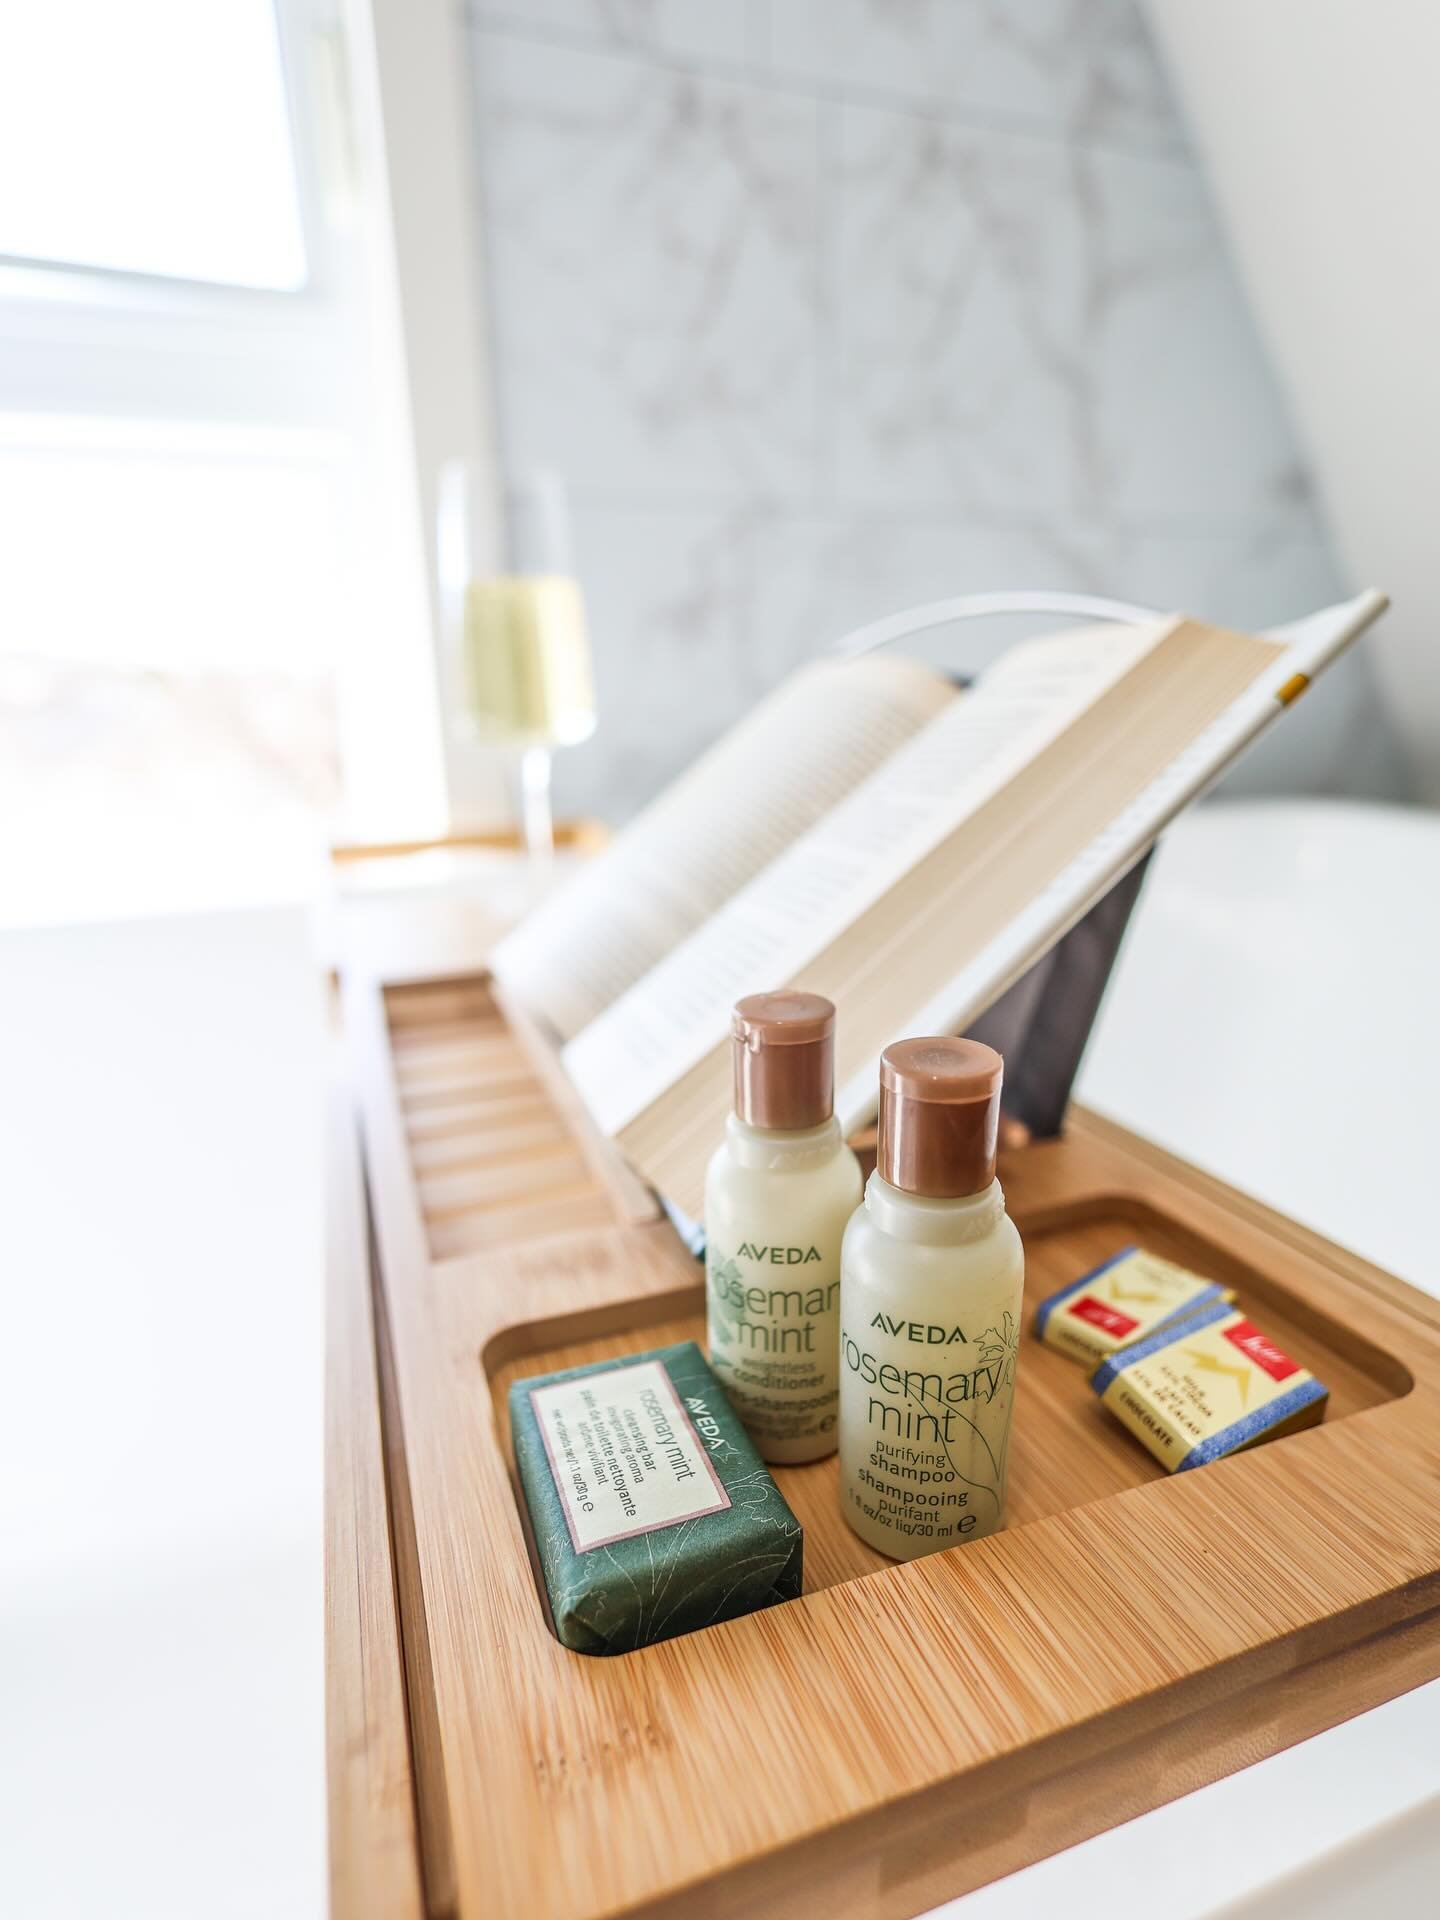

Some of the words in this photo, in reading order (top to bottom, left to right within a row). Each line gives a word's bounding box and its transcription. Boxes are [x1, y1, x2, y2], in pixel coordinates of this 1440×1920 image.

[737, 1243, 822, 1265] AVEDA
[714, 1271, 840, 1317] osemar
[739, 1319, 816, 1353] mint
[871, 1312, 968, 1345] AVEDA
[842, 1329, 1003, 1404] rosemary
[623, 1409, 649, 1453] cleansing
[642, 1453, 656, 1472] bar
[640, 1388, 677, 1446] rosemary
[665, 1445, 697, 1482] mint
[685, 1397, 727, 1450] AVEDA
[868, 1396, 957, 1443] mint
[1119, 1391, 1174, 1448] CHOCOLATE
[607, 1406, 632, 1454] invigorating
[626, 1454, 644, 1484] aroma
[876, 1440, 946, 1468] purifying
[588, 1447, 609, 1486] vivifiant
[593, 1421, 614, 1458] toilette
[607, 1458, 637, 1518] nettoyante
[858, 1468, 969, 1507] shampooing
[870, 1453, 955, 1484] shampoo
[879, 1499, 940, 1522] purifant
[937, 1524, 953, 1537] ml
